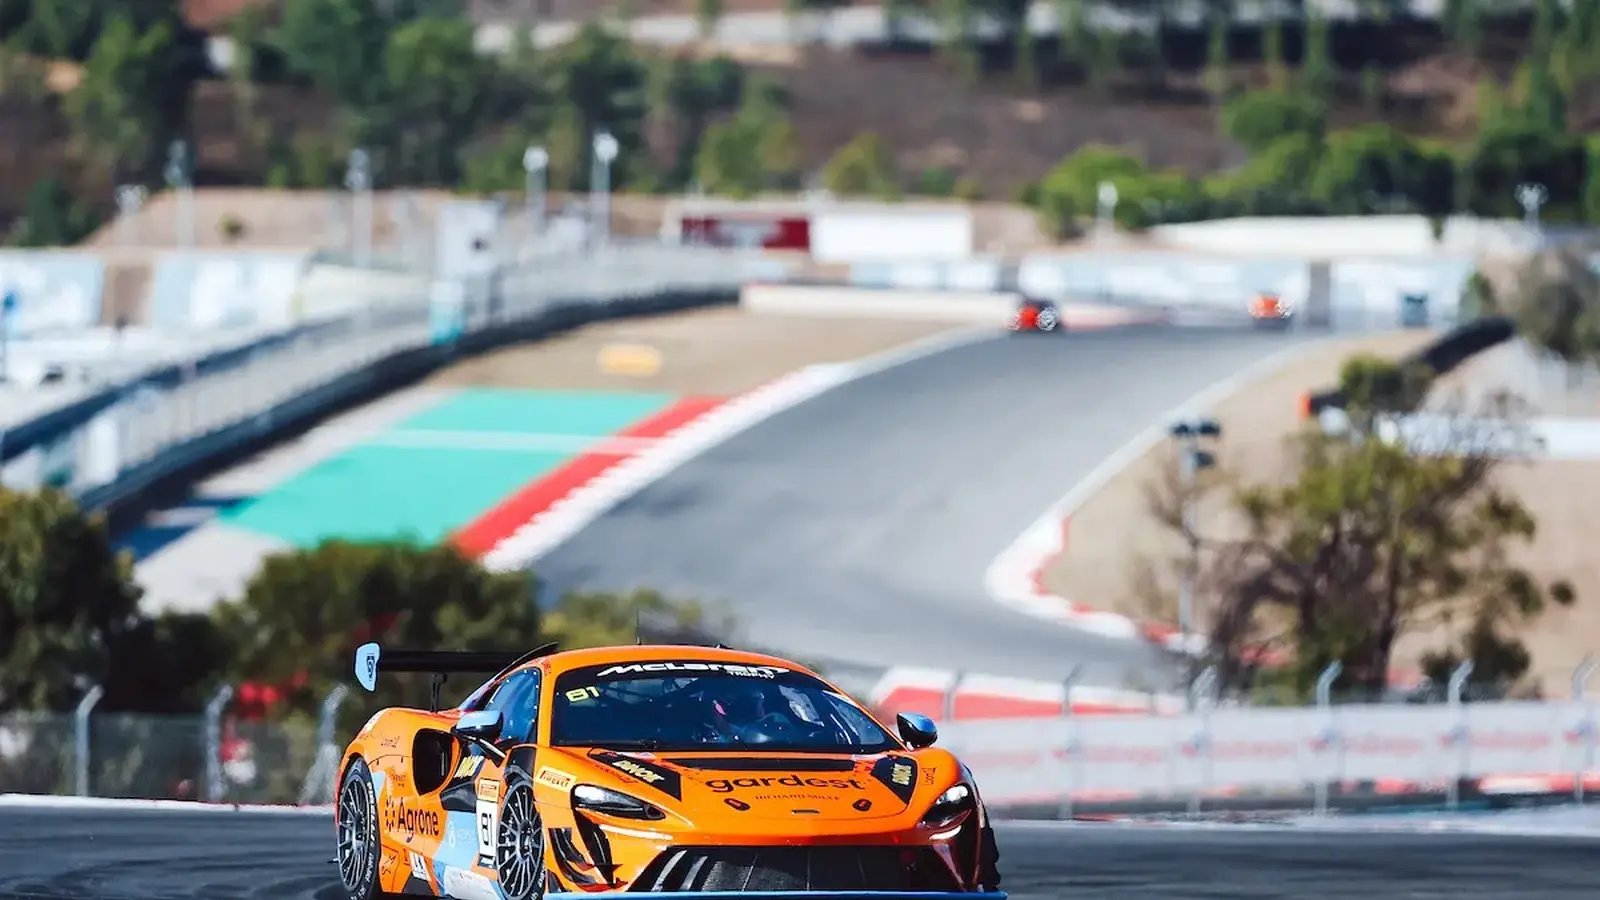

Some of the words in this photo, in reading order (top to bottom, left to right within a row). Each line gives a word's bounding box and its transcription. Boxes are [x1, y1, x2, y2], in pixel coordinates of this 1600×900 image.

[597, 663, 789, 676] McLaren
[565, 686, 600, 702] 81
[705, 775, 866, 793] gardest
[397, 797, 439, 843] Agrone
[481, 812, 493, 847] 81
